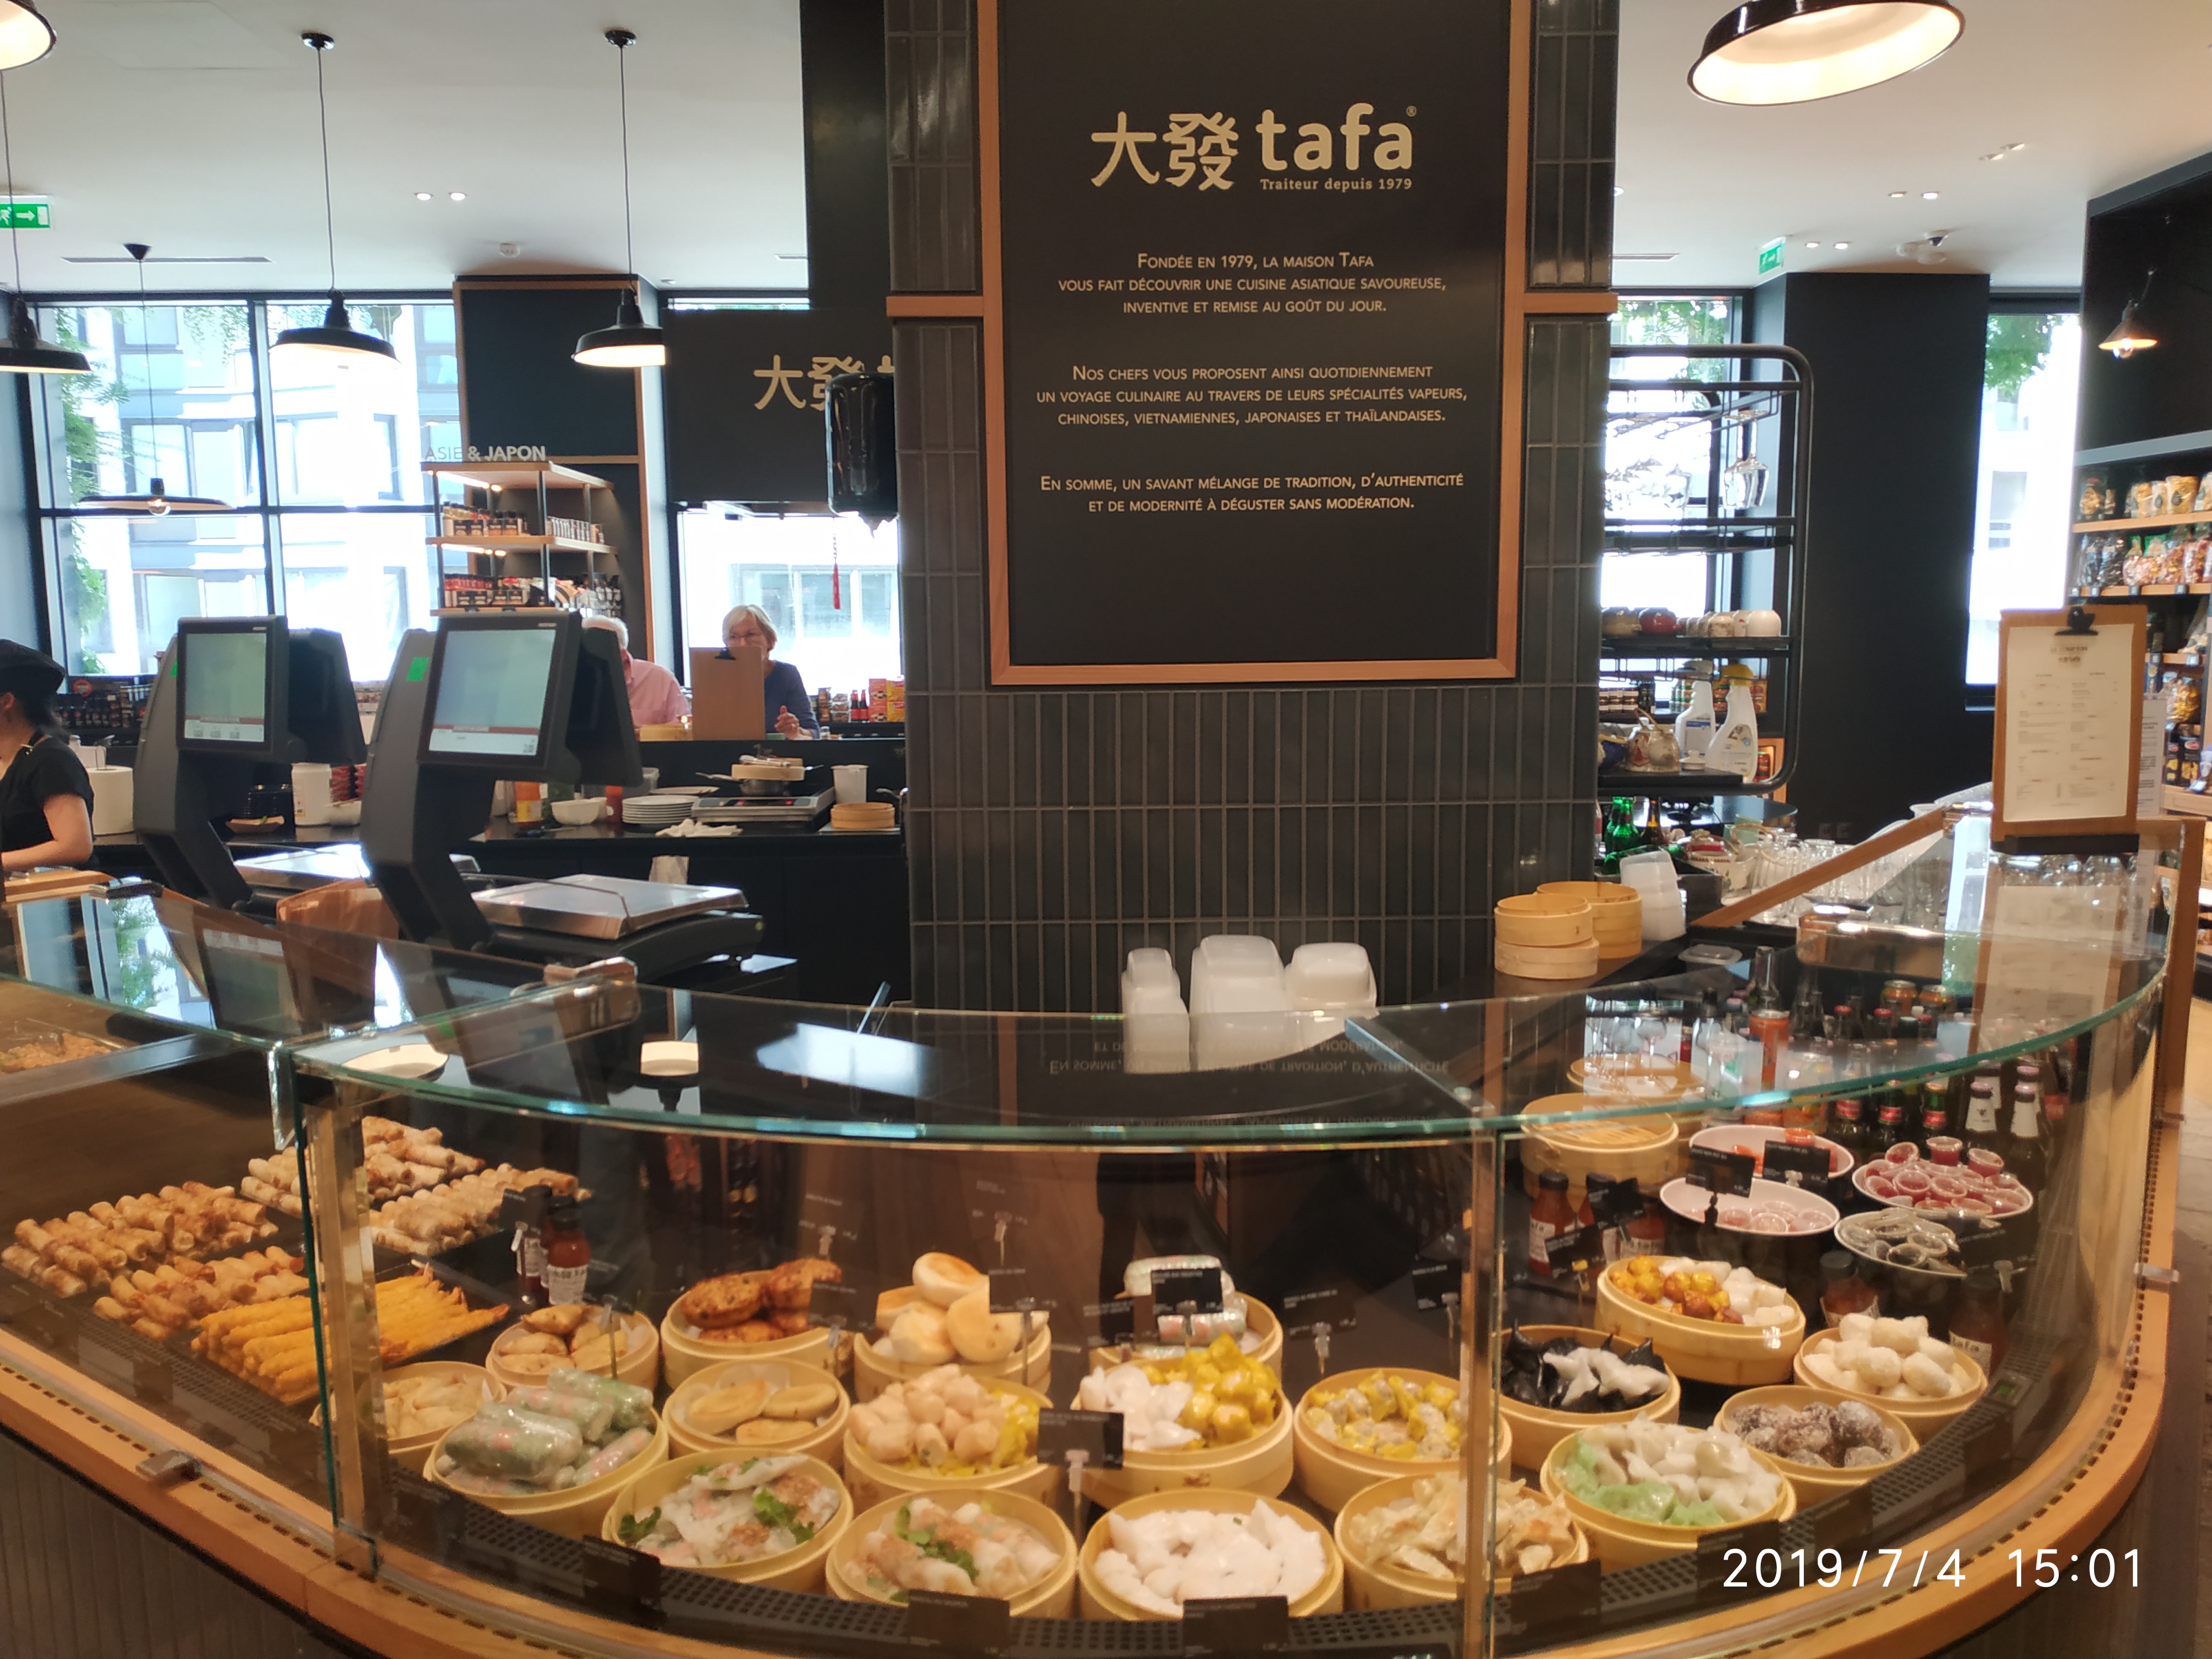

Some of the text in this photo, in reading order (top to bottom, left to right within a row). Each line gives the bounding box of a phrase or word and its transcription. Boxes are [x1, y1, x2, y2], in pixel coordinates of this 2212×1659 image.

[1255, 102, 1413, 171] tafa
[1091, 111, 1239, 191] 大發
[1260, 178, 1412, 193] Traiteur depuis 1979
[1138, 252, 1374, 270] FONDÉE EN 1979, LA MAISON TAFA
[1058, 277, 1446, 291] VOUS FAIT DÉCOUVRIR UNE CUISINE ASIATIQUE SAVOUREUSE,
[1124, 299, 1386, 314] INVENTIVE ET REMISE AU GOÛT DU JOUR.
[1073, 366, 1433, 380] NOS CHEFS VOUS PROPOSENT AINSI QUOTIDIENNEMENT
[1037, 387, 1467, 403] UN VOYAGE CULINAIRE AU TRAVERS DE LEURS SPÉCIALITÉS VAPEURS,
[1058, 409, 1446, 426] CHINOISES, VIETNAMIENNES, JAPONAISES ET THAÏLANDAISES.
[425, 446, 546, 461] ASIE & JAPON
[1041, 472, 1464, 493] EN SOMME, UN SAVANT MÉLANGE DE TRADITION, D'AUTHENTICITÉ
[1089, 495, 1415, 512] ET DE MODERNITÉ À DÉGUSTER SANS MODÉRATION.
